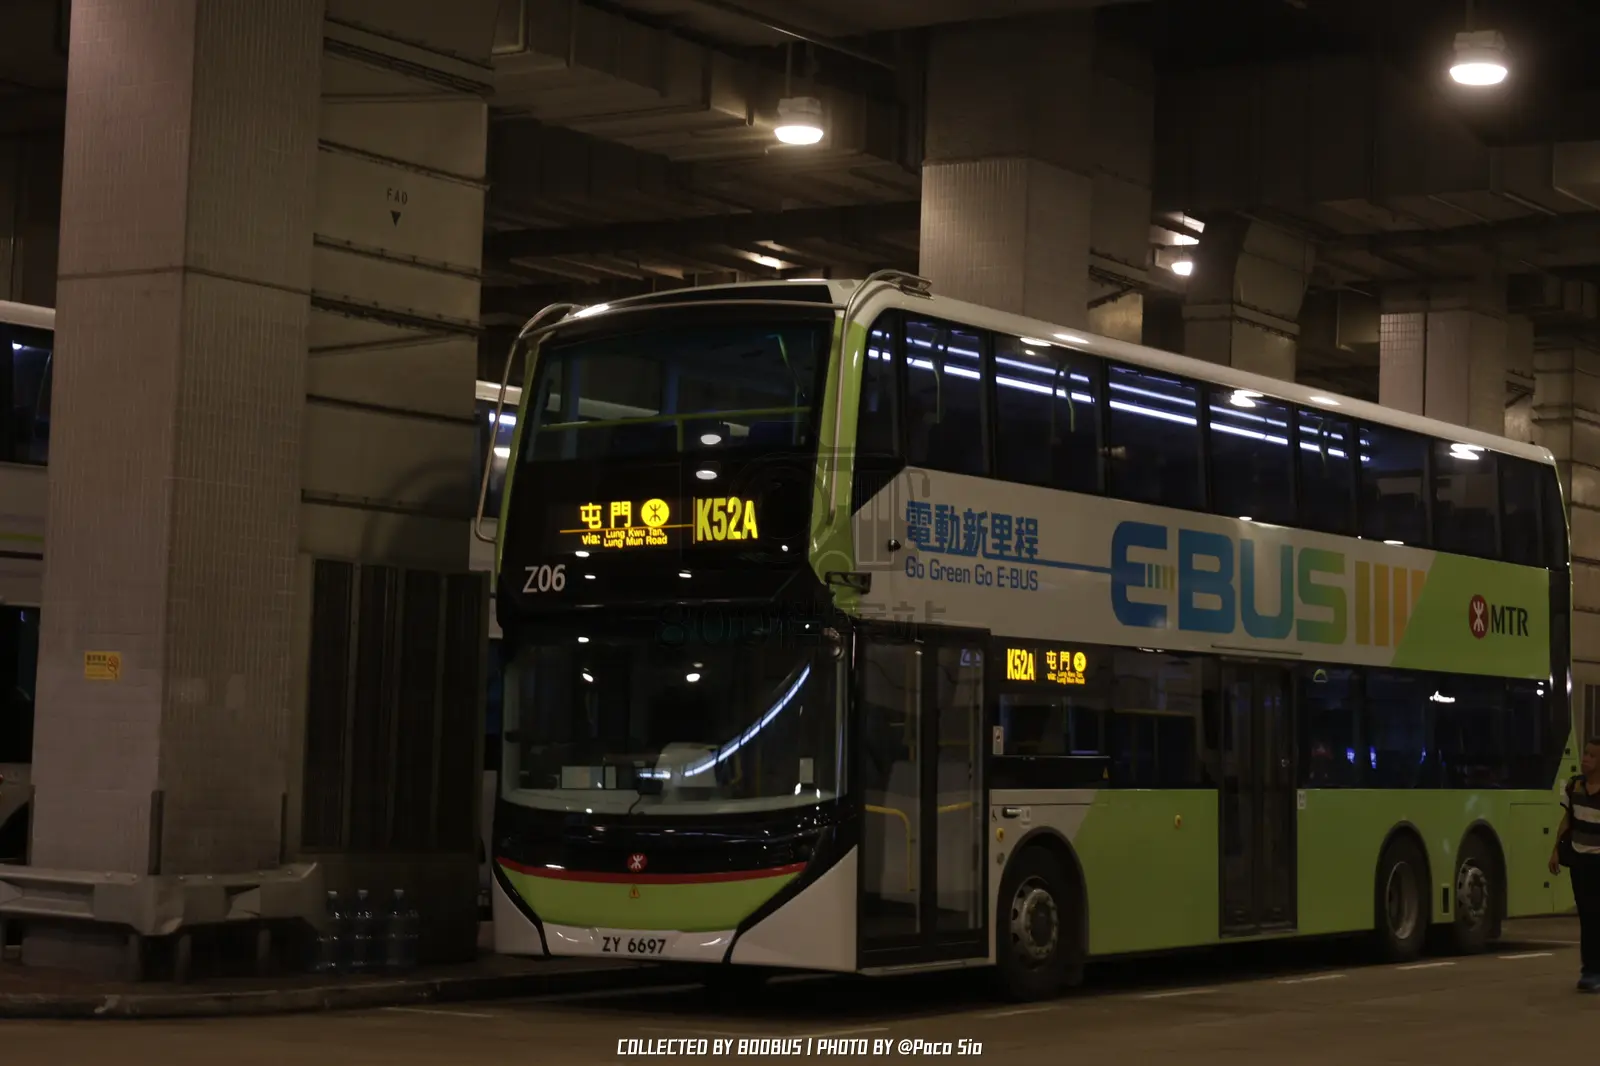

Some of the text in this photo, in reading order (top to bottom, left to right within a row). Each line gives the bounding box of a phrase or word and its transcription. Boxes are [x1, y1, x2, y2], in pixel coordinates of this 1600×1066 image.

[580, 501, 632, 530] 屯門
[697, 497, 758, 541] K52A
[582, 532, 601, 545] via:
[603, 535, 668, 548] Lung Mun Road
[605, 529, 625, 539] Lung
[628, 528, 645, 537] Kwu
[906, 501, 1039, 560] 電動新里程
[522, 564, 566, 593] Z06
[906, 556, 1038, 591] Go Green Go E-BUS
[1491, 605, 1528, 637] MTR
[1007, 649, 1034, 680] K52A
[1046, 650, 1070, 671] 屯門
[602, 936, 666, 953] ZY 6697
